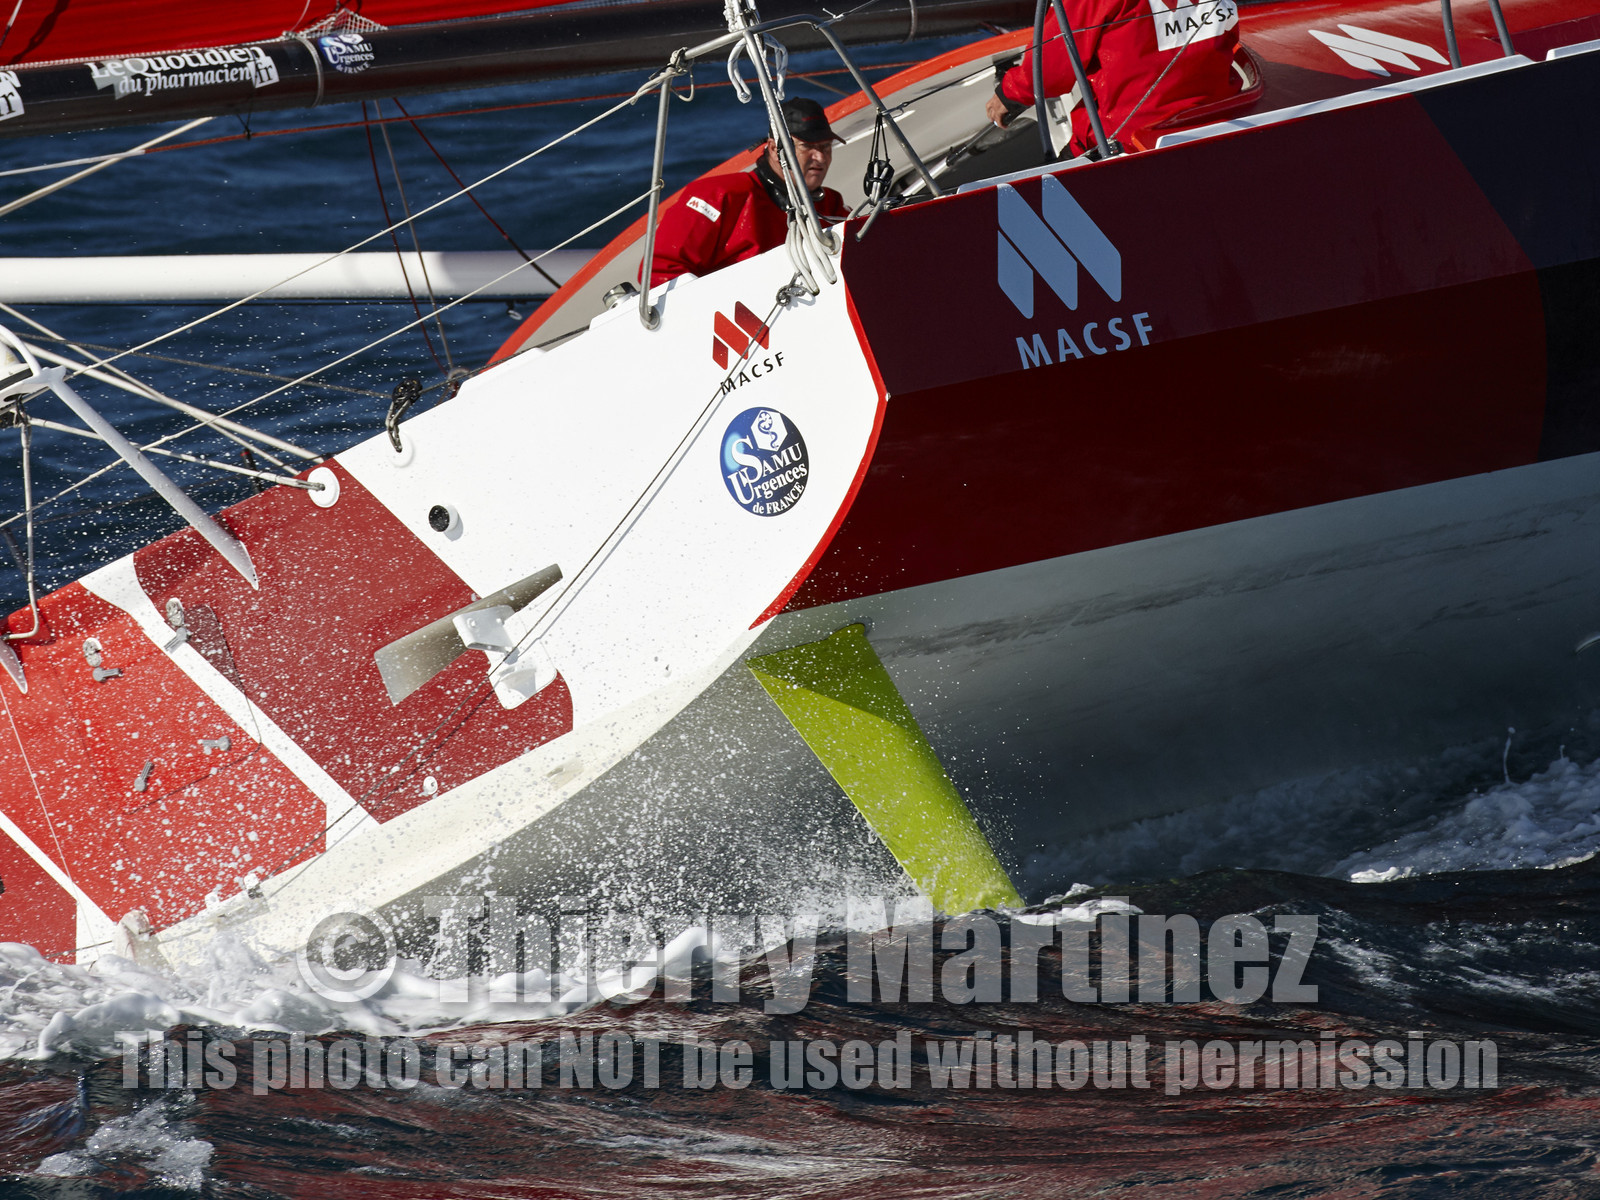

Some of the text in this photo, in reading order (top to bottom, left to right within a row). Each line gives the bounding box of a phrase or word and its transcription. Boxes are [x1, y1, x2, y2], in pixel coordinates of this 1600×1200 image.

[119, 76, 144, 95] du
[143, 64, 252, 97] pharmacien
[1015, 311, 1153, 370] MACSF
[719, 351, 785, 396] MACSF
[731, 434, 803, 484] SAMU
[727, 463, 808, 505] Urgences
[752, 481, 805, 515] de FRANCE
